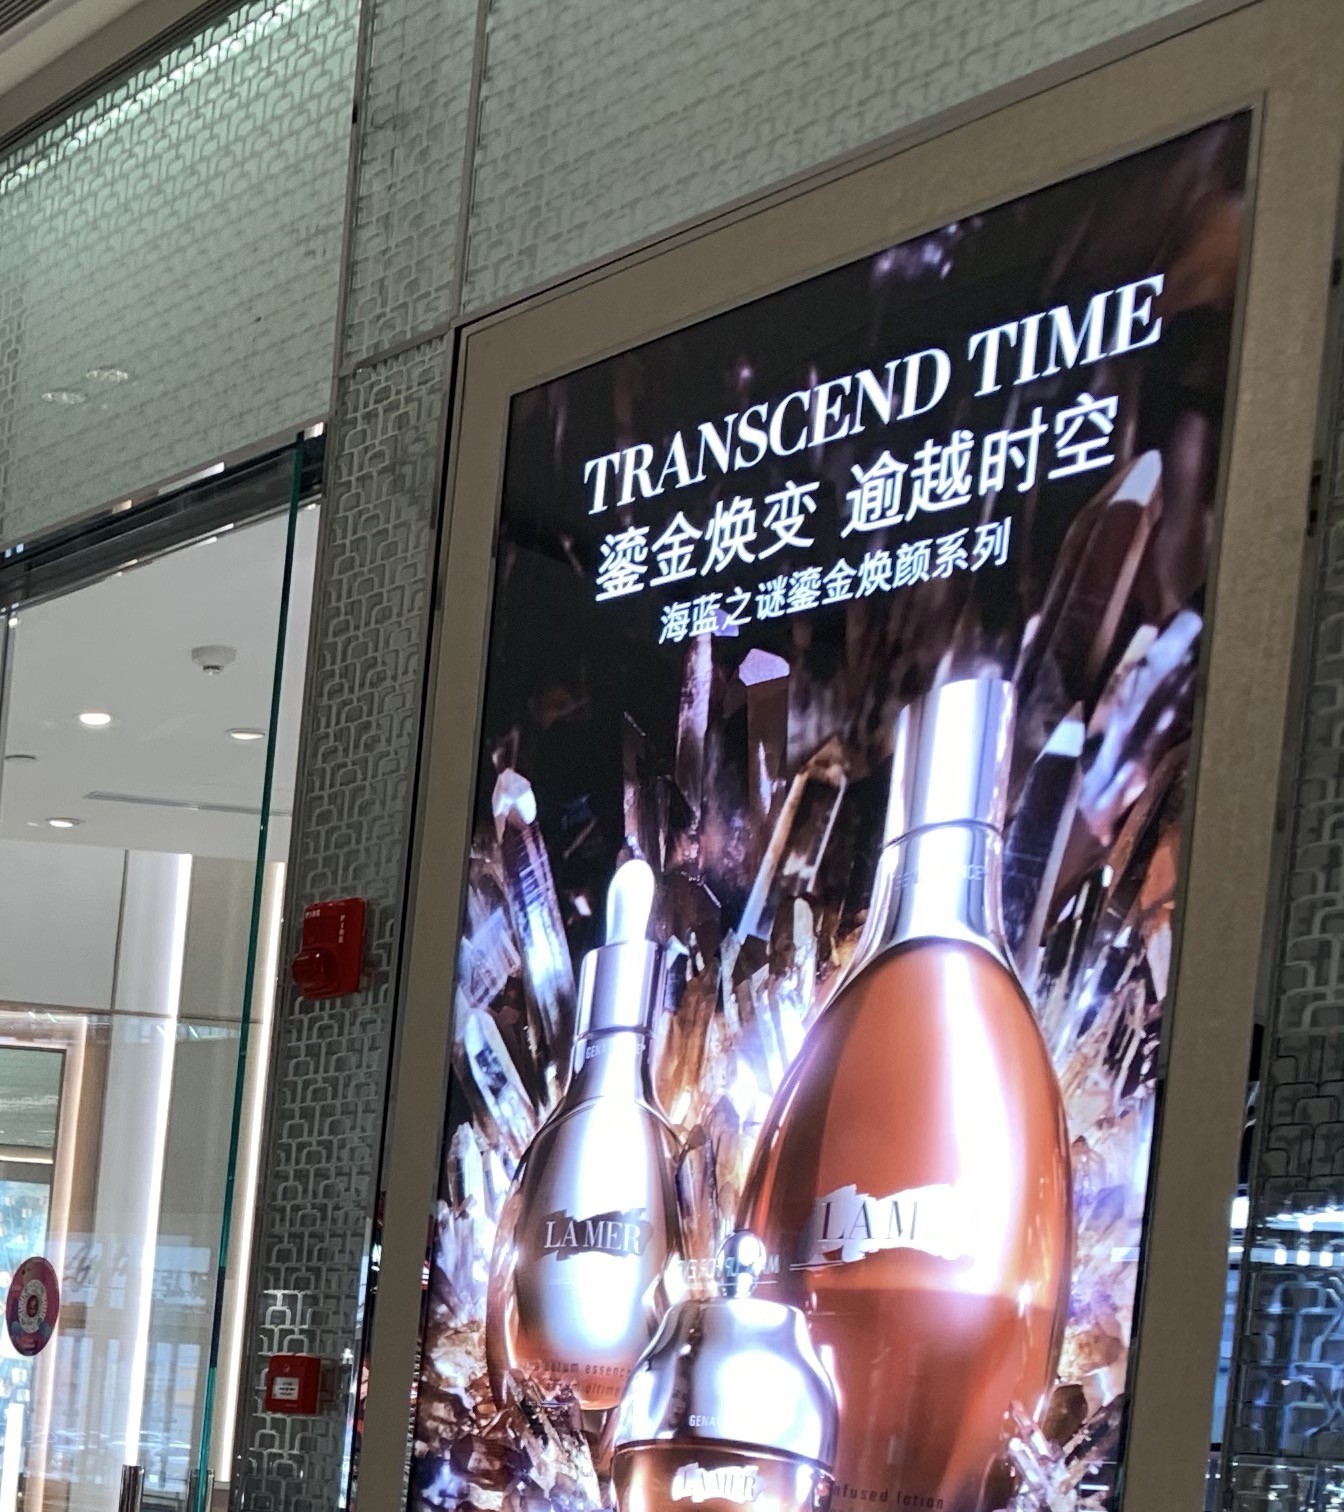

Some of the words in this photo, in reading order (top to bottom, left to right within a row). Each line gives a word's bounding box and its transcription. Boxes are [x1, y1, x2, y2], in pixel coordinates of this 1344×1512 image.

[583, 348, 952, 515] TRANSCEND
[969, 274, 1164, 398] TIME
[595, 480, 822, 602] 鎏金焕变
[841, 393, 1119, 540] 逾越时空
[658, 516, 1013, 645] 海蓝之谜鎏金焕颜系列
[543, 1220, 579, 1249] LA
[583, 1220, 641, 1254] MER
[816, 1200, 875, 1241] LA
